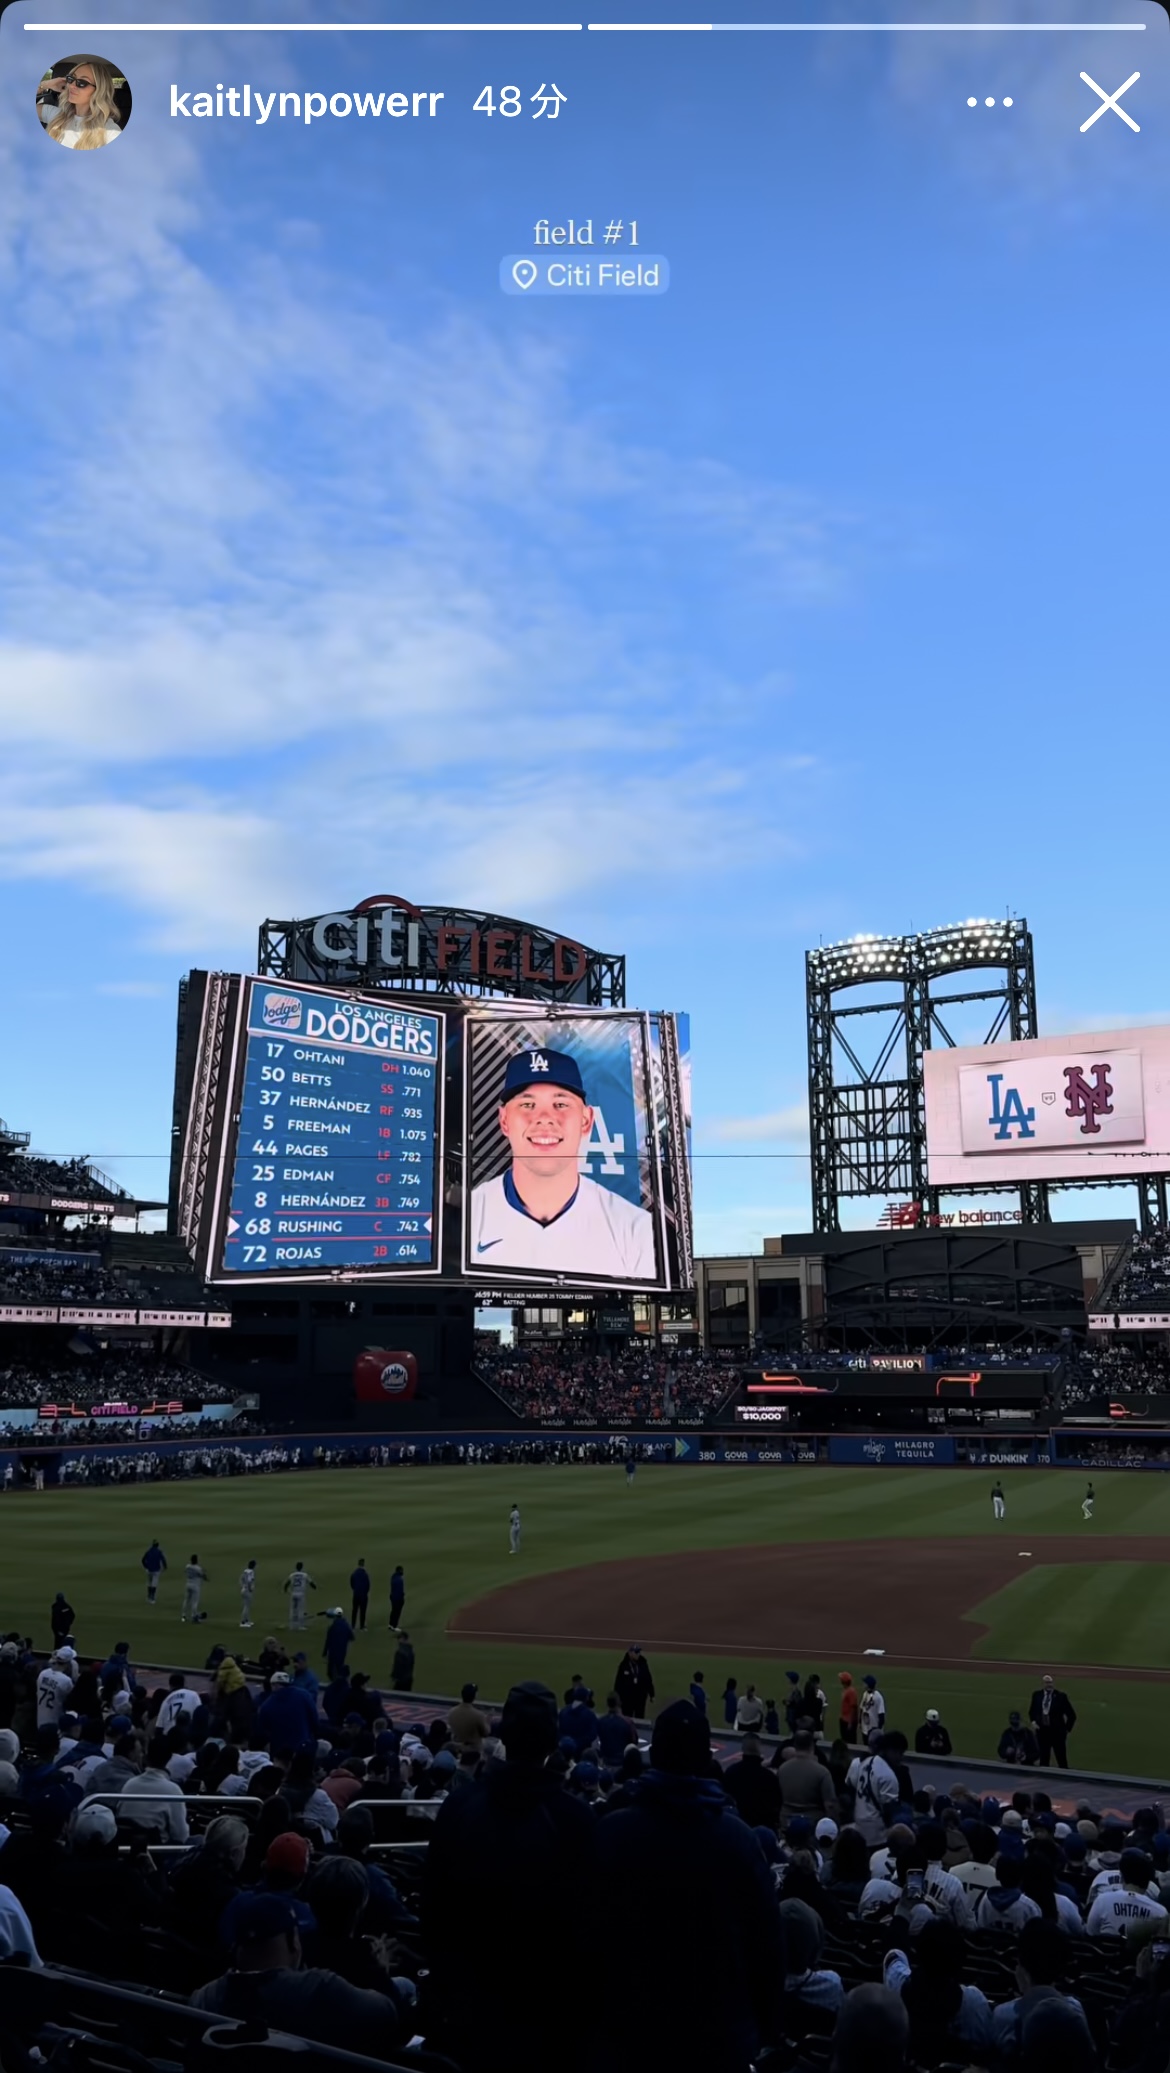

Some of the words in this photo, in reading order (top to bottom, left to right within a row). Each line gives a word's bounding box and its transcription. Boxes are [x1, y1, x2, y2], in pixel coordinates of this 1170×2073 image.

[313, 906, 419, 968] citi
[437, 926, 586, 982] FIELD
[335, 1003, 361, 1017] LOS
[364, 1007, 422, 1029] ANGELES
[306, 1008, 432, 1055] DODGERS
[267, 1043, 284, 1058] 17
[293, 1049, 345, 1066] OHTANI
[382, 1063, 399, 1073] DH
[402, 1065, 431, 1079] 1.040
[261, 1066, 285, 1082] 50
[292, 1072, 332, 1086] BETTS
[381, 1084, 394, 1094] SS
[402, 1086, 421, 1098] .771
[259, 1090, 281, 1106] 37
[289, 1096, 371, 1114] HERNÁNDEZ
[380, 1105, 394, 1115] RF
[401, 1108, 422, 1119] .935
[262, 1115, 274, 1130] 5
[287, 1119, 351, 1134] FREEMAN
[378, 1127, 391, 1138] 1B
[400, 1129, 427, 1141] 1.075
[252, 1139, 278, 1155] 44
[285, 1143, 328, 1157] PAGES
[377, 1150, 390, 1161] LF
[399, 1151, 421, 1162] .782
[251, 1165, 275, 1181] 25
[283, 1169, 334, 1182] EDMAN
[376, 1173, 391, 1183] CF
[399, 1174, 421, 1185] .754
[51, 1199, 89, 1210] DODGERS
[254, 1192, 267, 1208] 8
[280, 1193, 366, 1208] HERNÁNDEZ
[375, 1197, 389, 1208] 3B
[398, 1197, 419, 1209] .749
[925, 1212, 955, 1225] new
[959, 1209, 1023, 1224] balance
[245, 1218, 271, 1235] 68
[278, 1221, 342, 1233] RUSHING
[373, 1221, 382, 1232] C
[396, 1221, 419, 1232] .742
[243, 1246, 267, 1263] 72
[276, 1247, 322, 1260] ROJAS
[373, 1245, 388, 1257] 2B
[395, 1245, 417, 1256] .614
[872, 1359, 922, 1369] PAVILION
[91, 1406, 110, 1415] CITI
[112, 1405, 138, 1415] FIELD
[742, 1412, 782, 1422] $10,000
[894, 1441, 935, 1449] MILAGRO
[896, 1449, 934, 1458] TEQUILA
[699, 1451, 716, 1460] 380
[724, 1451, 748, 1460] GOYA
[758, 1451, 781, 1460] GOYA
[989, 1453, 1029, 1464] DUNKIN'
[1037, 1453, 1050, 1464] 370
[1081, 1459, 1142, 1468] CADILLAC
[39, 1687, 55, 1709] 72
[169, 1702, 183, 1721] 17
[1113, 1902, 1150, 1918] OHTANI
